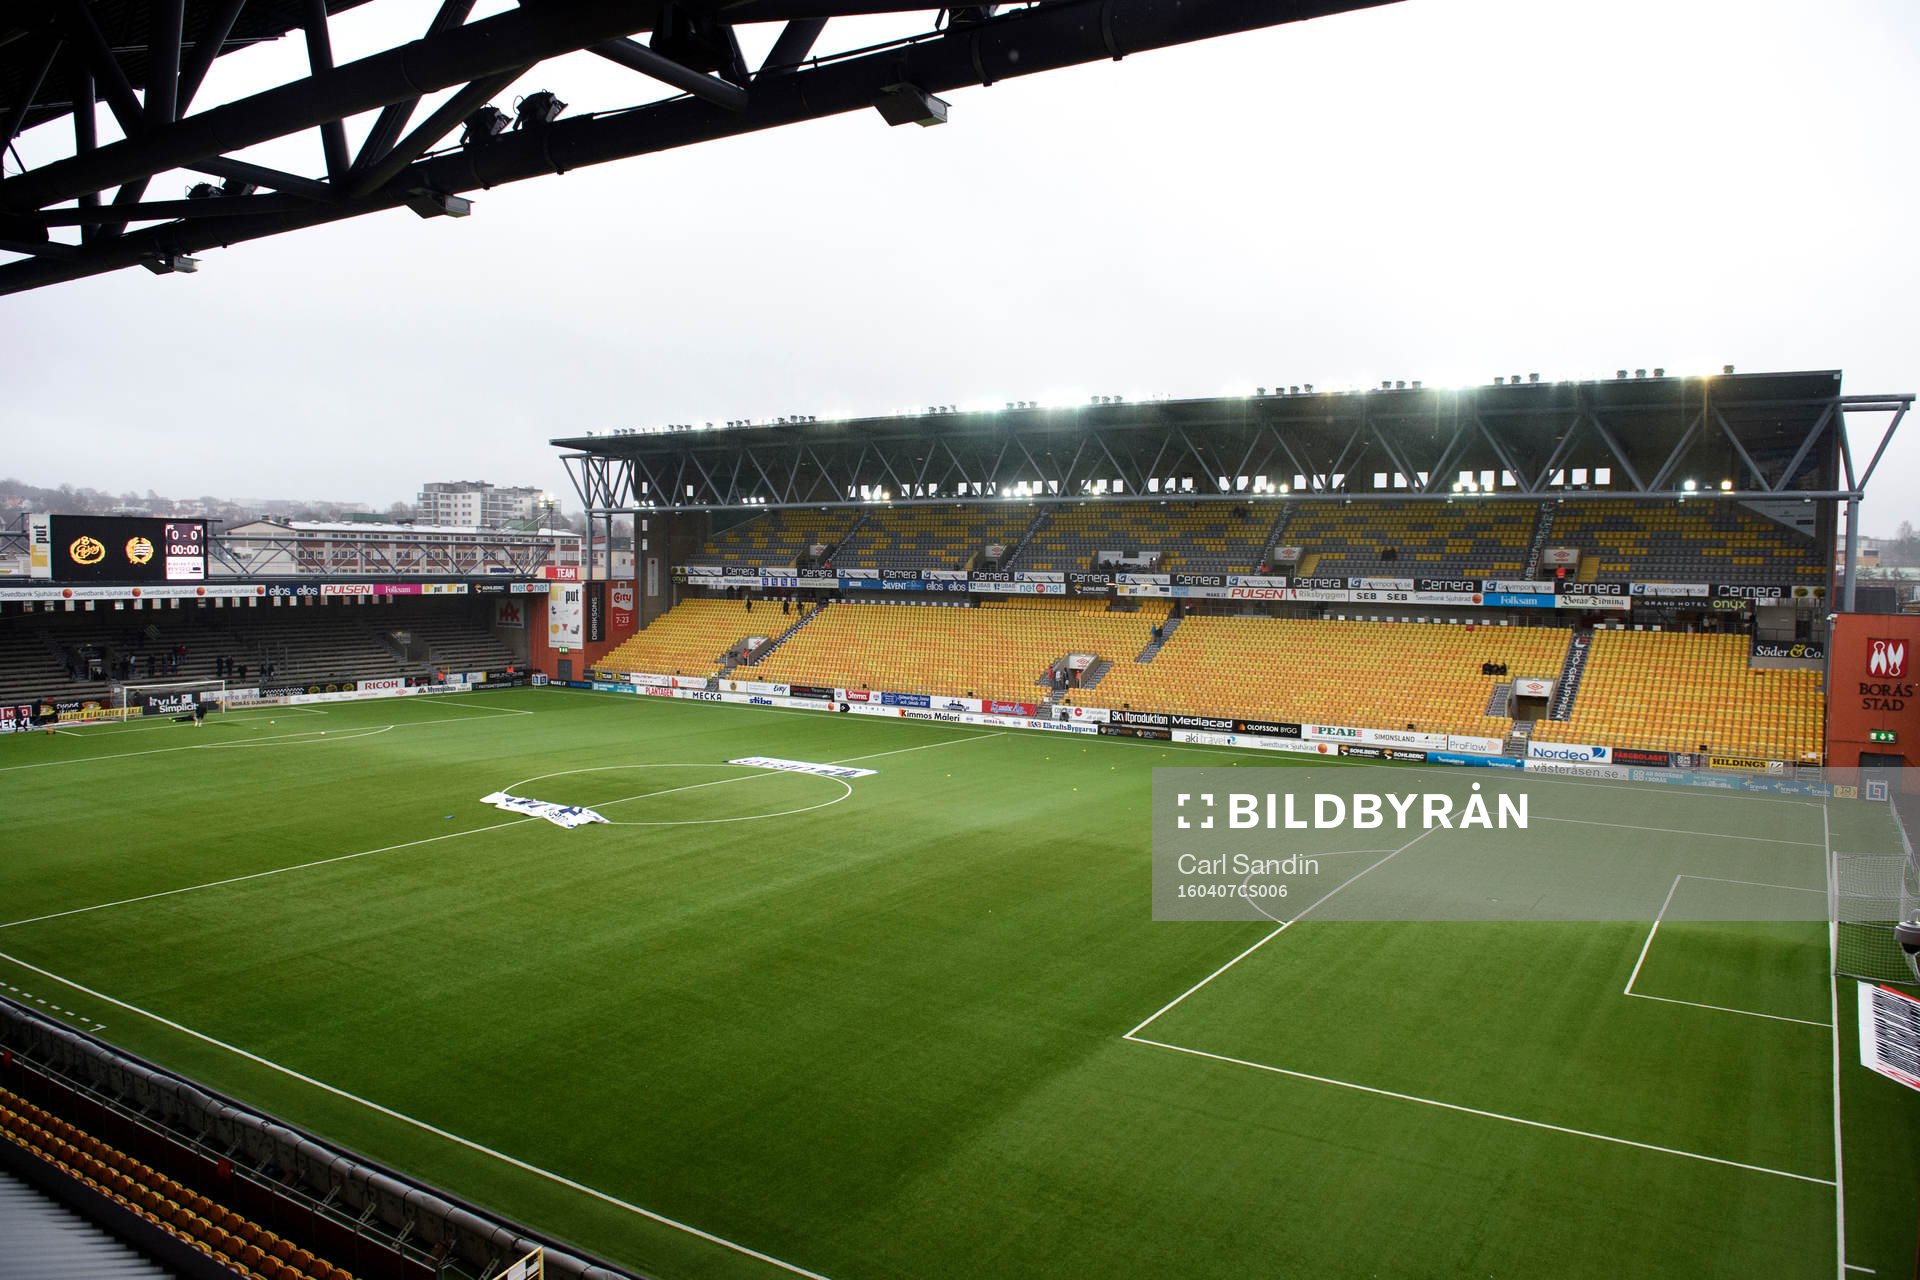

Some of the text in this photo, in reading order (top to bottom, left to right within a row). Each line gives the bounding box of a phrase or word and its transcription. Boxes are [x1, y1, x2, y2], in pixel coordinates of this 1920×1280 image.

[171, 545, 199, 555] 00:00
[556, 568, 575, 578] TEAM
[801, 568, 833, 578] Cernera
[883, 570, 917, 579] Cernera
[972, 571, 1009, 581] Cernera
[1070, 573, 1110, 583] Cernera
[1176, 575, 1220, 585] Cernera
[1293, 577, 1341, 589] Cernera
[269, 585, 318, 596] ellos ellos
[324, 585, 371, 595] PULSEN
[385, 585, 411, 593] Folksam
[926, 581, 966, 592] ellos ellos
[1421, 580, 1474, 591] Cernera
[1563, 582, 1621, 594] Cernera
[565, 589, 579, 604] put
[1231, 588, 1284, 599] PULSEN
[1298, 590, 1346, 600] Riksbyggen
[1356, 592, 1408, 601] SEB SEB
[1718, 585, 1782, 598] Cernera
[1500, 595, 1538, 605] Folksam
[1713, 600, 1747, 610] onyx
[1756, 645, 1789, 657] Söder
[1804, 647, 1825, 658] Co.
[364, 680, 398, 690] RICOH
[1859, 682, 1913, 697] BORÅS
[645, 687, 674, 697] PLANTAGEN
[692, 691, 722, 701] MECKA
[159, 703, 199, 713] Simplicit
[1862, 698, 1905, 711] STAD
[901, 709, 960, 722] Kimmos Måleri
[1172, 715, 1233, 728] Mediacad
[1247, 724, 1298, 734] OLOFSSON BYGG
[1317, 726, 1357, 737] PEAB
[1374, 733, 1415, 743] SIMONSLAND
[1449, 741, 1487, 752] ProFlow
[1533, 748, 1589, 761] Nordea
[1713, 758, 1766, 768] HILDINGS
[1533, 763, 1619, 779] västeråsen.se
